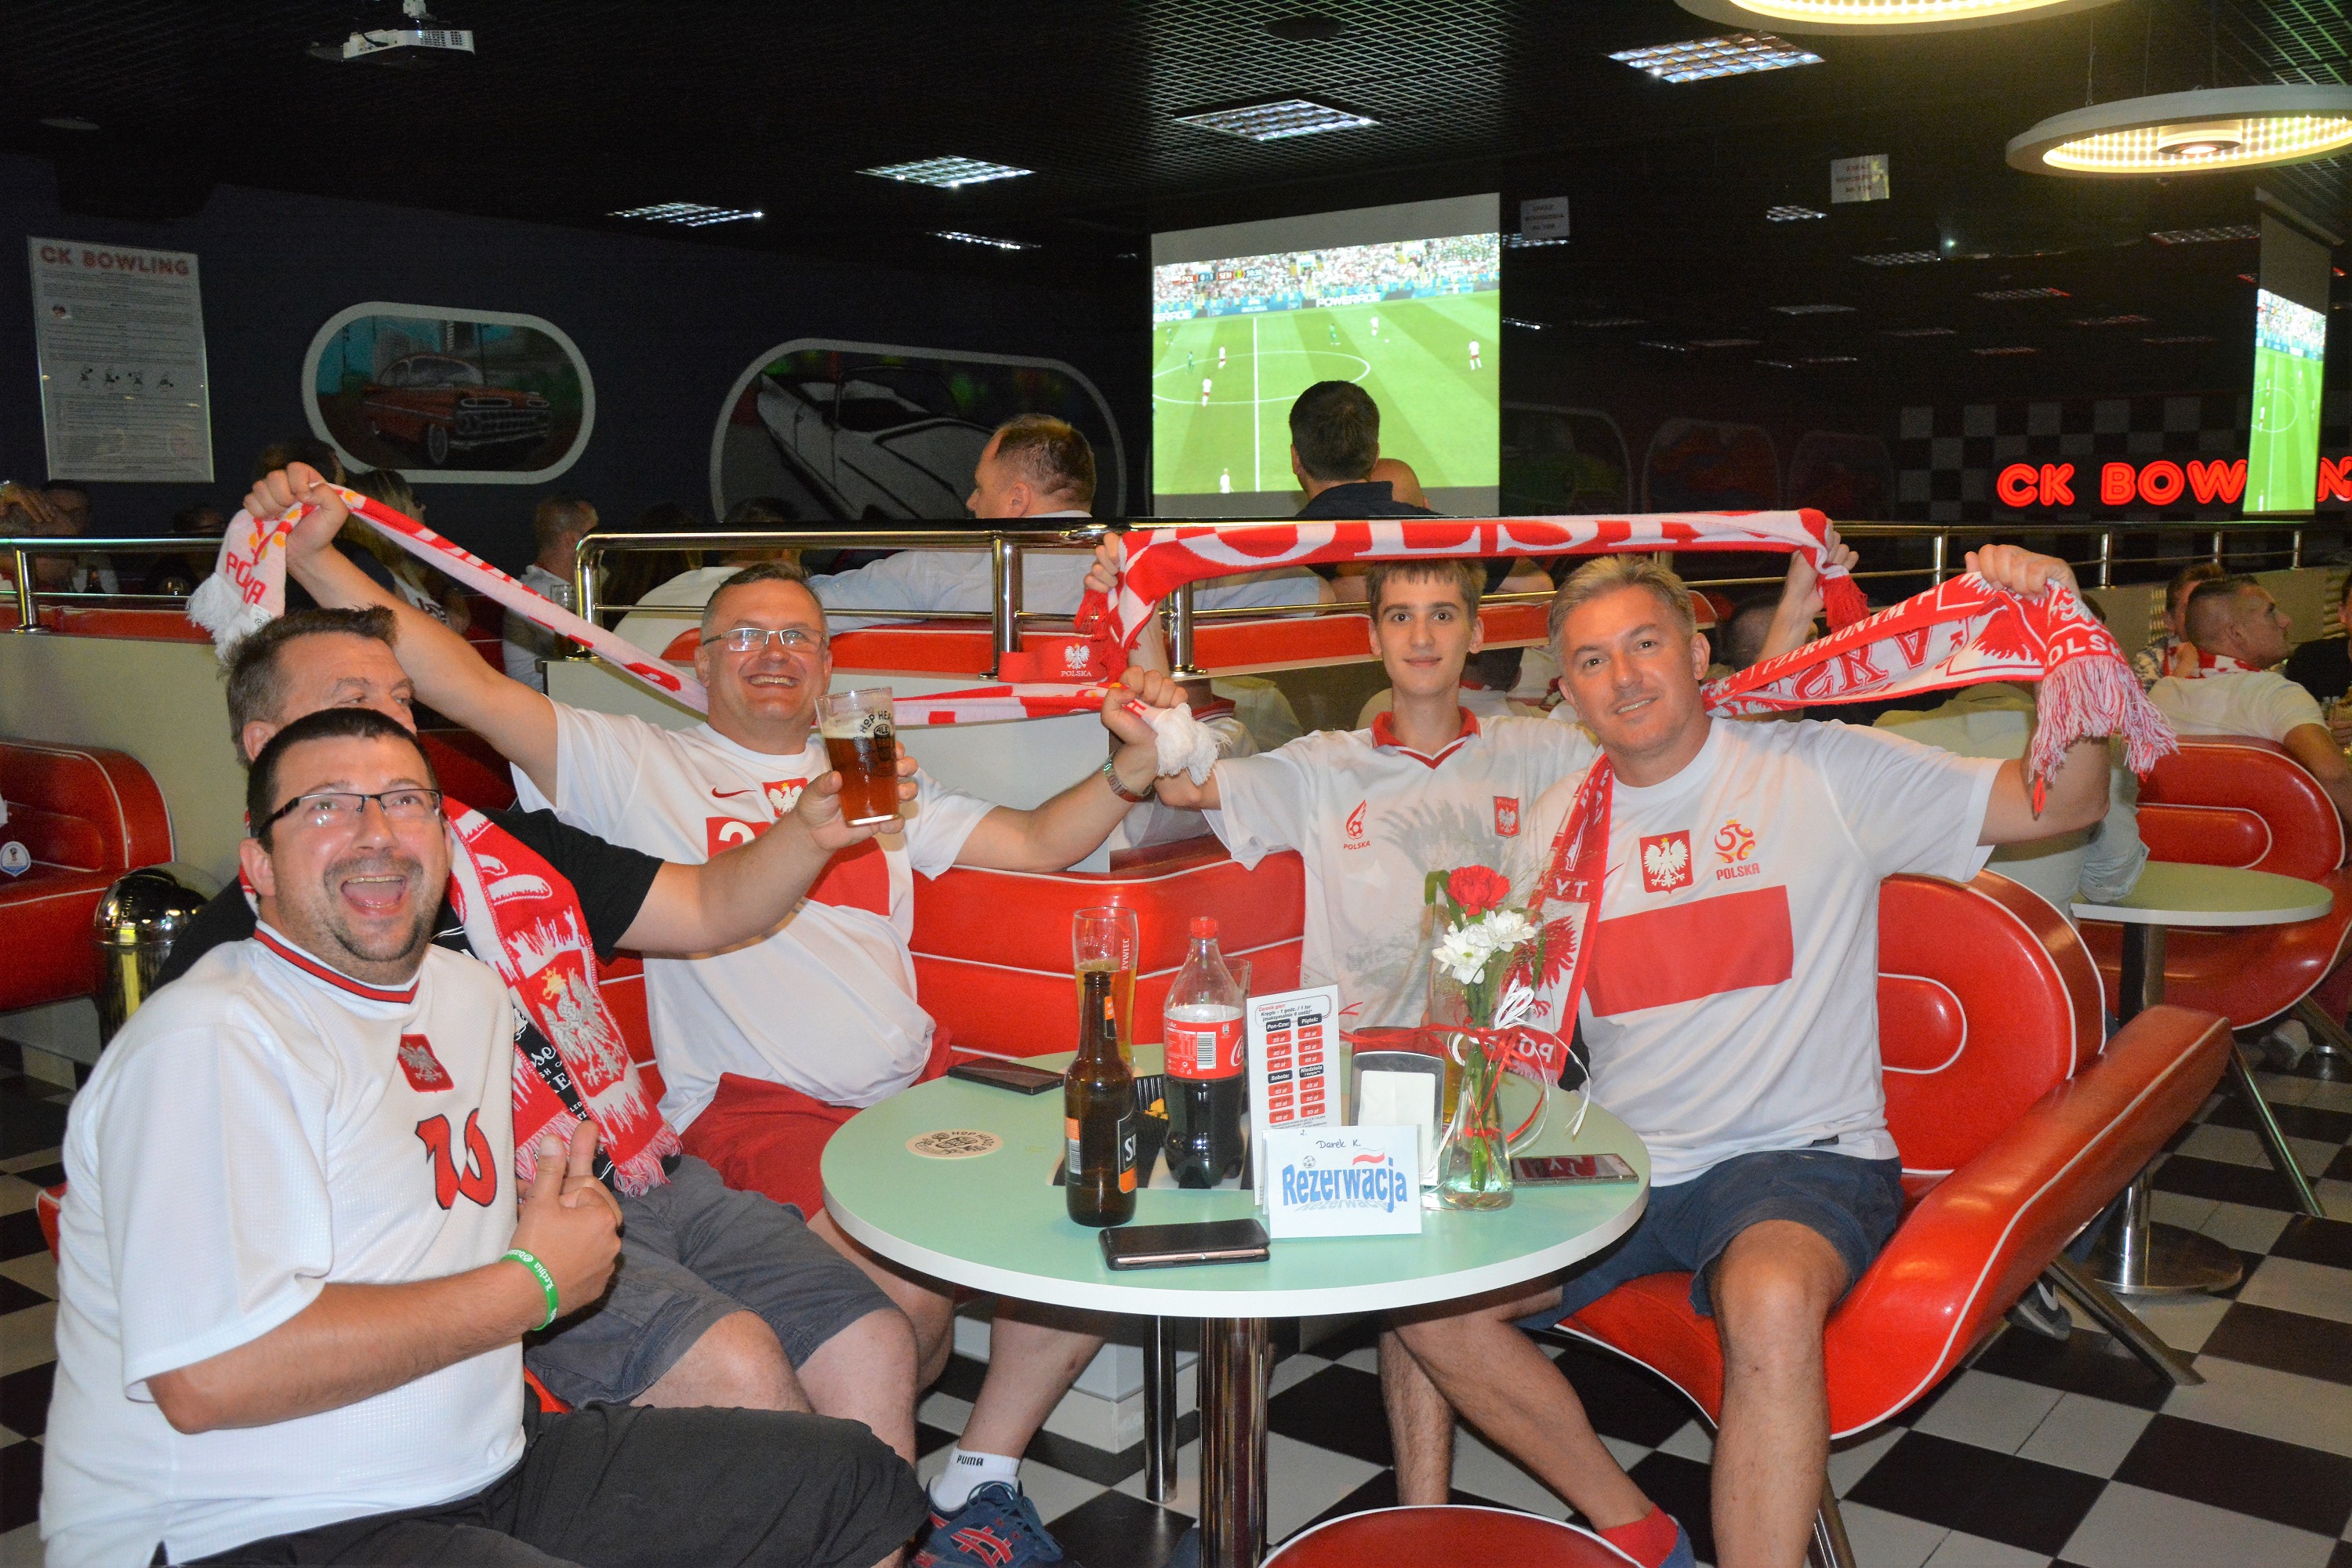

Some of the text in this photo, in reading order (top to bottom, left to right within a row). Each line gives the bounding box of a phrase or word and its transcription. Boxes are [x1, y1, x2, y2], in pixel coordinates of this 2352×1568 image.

[40, 245, 189, 276] CK BOWLING
[1316, 292, 1381, 307] POWERADE
[1996, 463, 2075, 507] CK
[876, 725, 889, 735] ALE
[1343, 840, 1370, 850] POLSKA
[1716, 862, 1761, 880] POLSKA
[1316, 1138, 1361, 1149] Darek K.
[1282, 1156, 1408, 1214] Rezerwacja
[956, 1454, 985, 1466] PUMA
